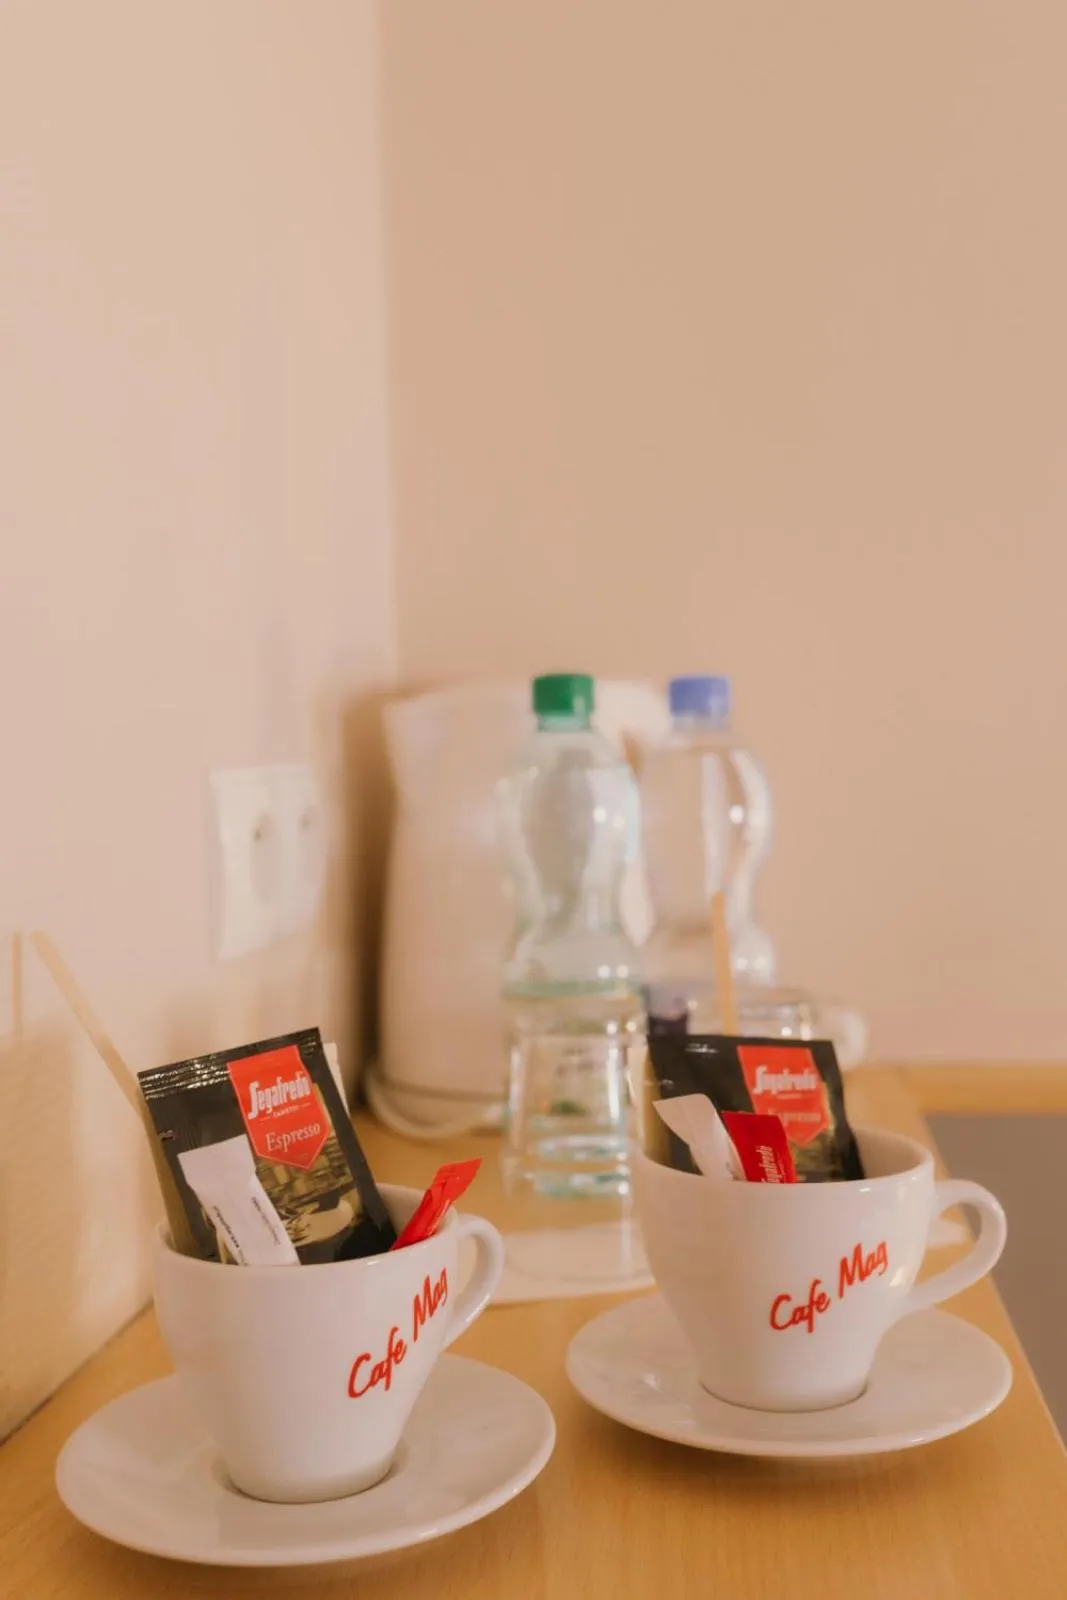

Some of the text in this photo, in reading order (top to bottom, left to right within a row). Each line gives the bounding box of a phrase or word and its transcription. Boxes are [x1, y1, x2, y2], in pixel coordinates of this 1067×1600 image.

[248, 1071, 312, 1120] Segafredo
[265, 1122, 320, 1153] Espresso
[769, 1241, 888, 1334] Cafe Mag
[348, 1266, 448, 1398] Cafe Mag
